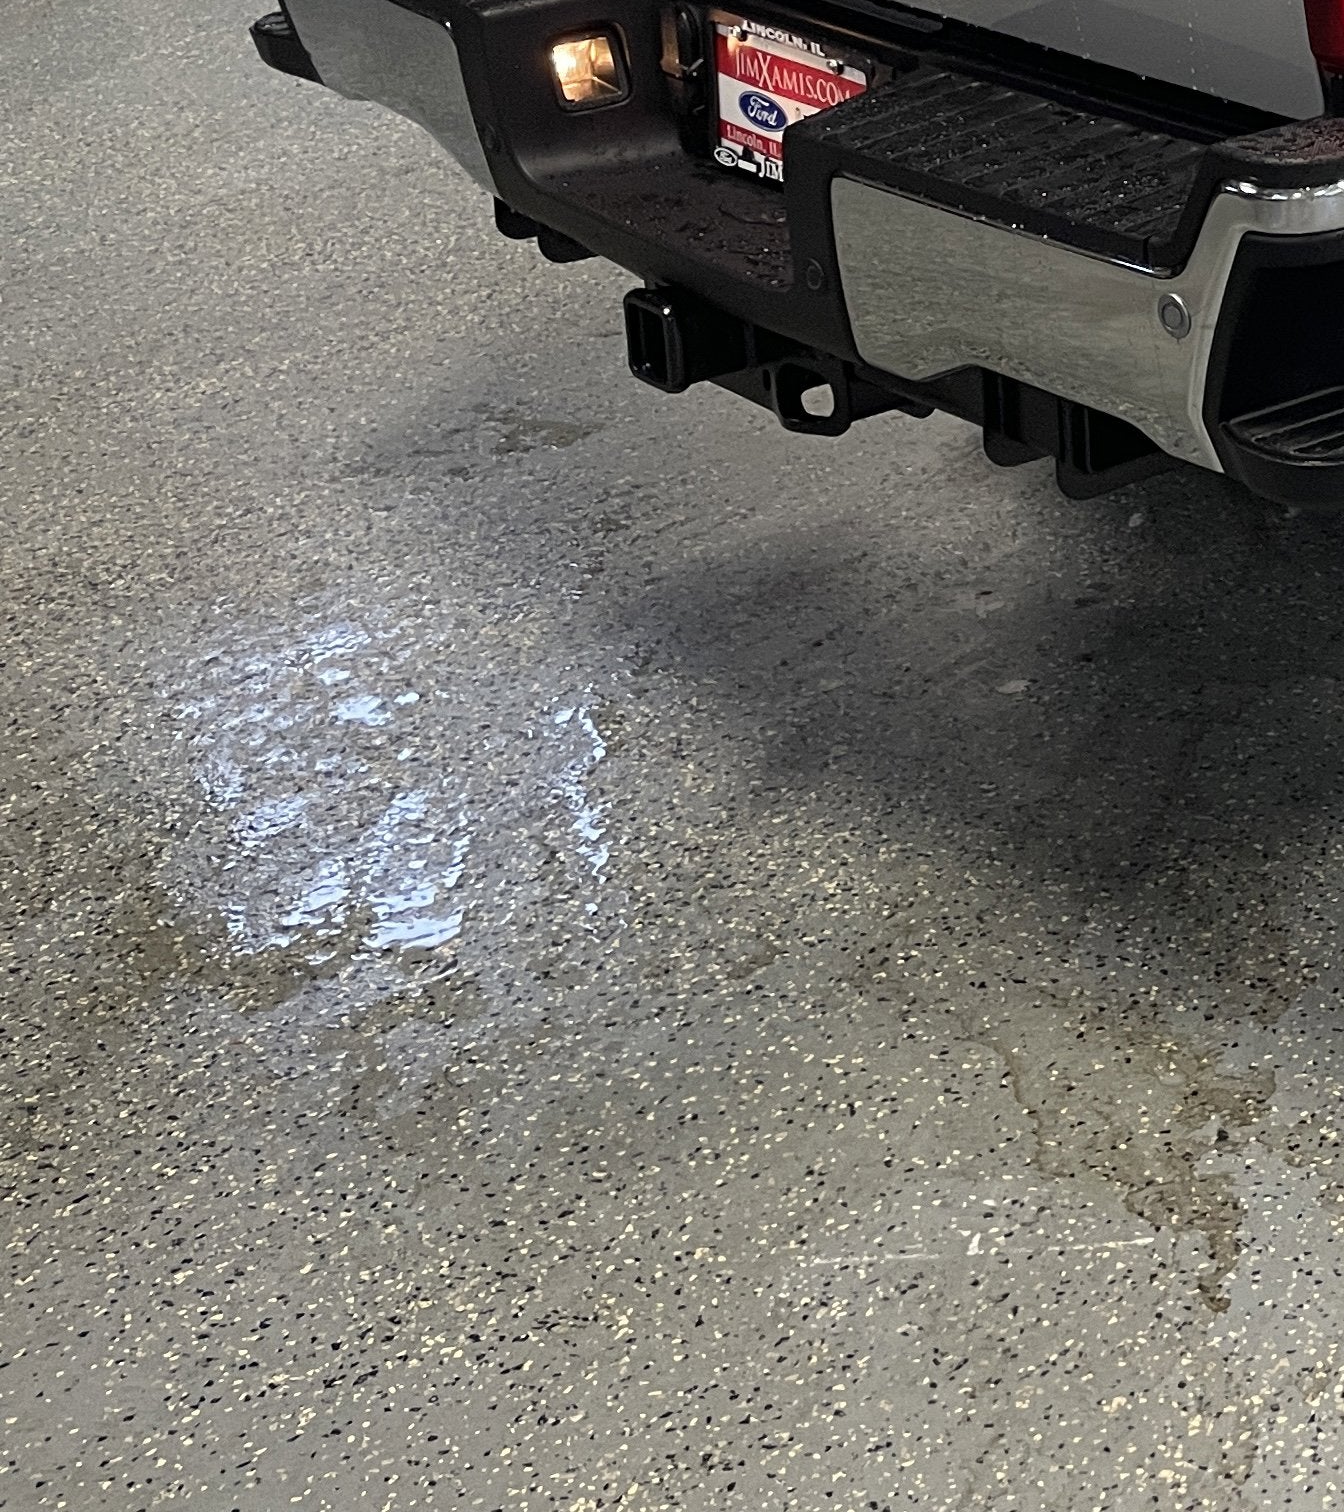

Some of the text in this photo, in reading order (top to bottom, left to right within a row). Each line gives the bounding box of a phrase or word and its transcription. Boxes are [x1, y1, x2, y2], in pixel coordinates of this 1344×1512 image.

[810, 41, 826, 57] IL
[748, 95, 778, 126] Ford
[759, 159, 785, 182] JIM
